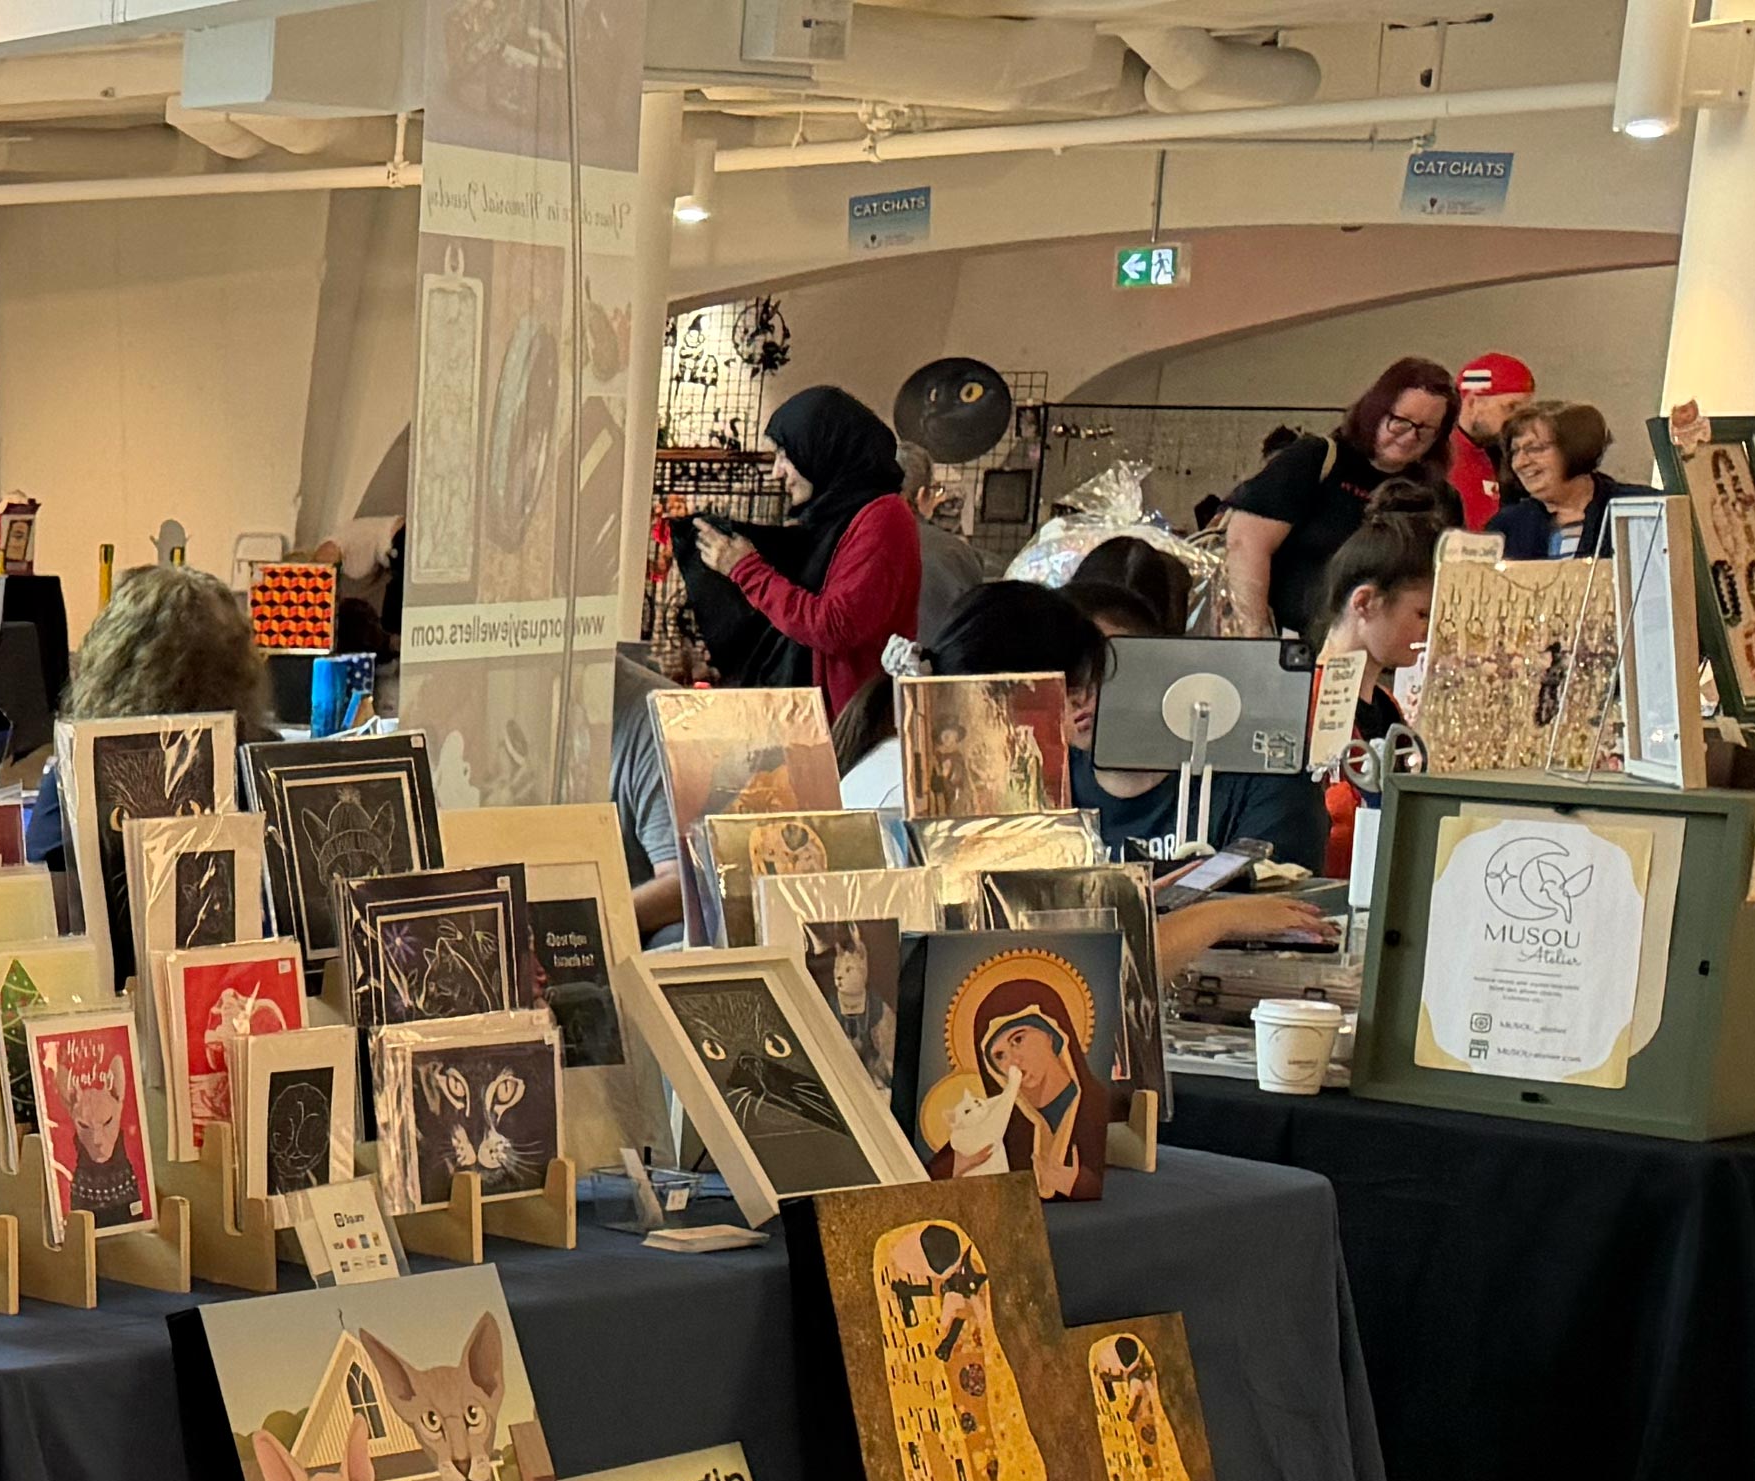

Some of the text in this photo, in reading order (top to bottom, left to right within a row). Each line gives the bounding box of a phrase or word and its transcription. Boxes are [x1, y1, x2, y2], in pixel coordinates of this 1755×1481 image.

[1413, 160, 1505, 176] CAT CHATS
[853, 195, 926, 217] CAT CHATS
[1484, 923, 1580, 949] MUSOU
